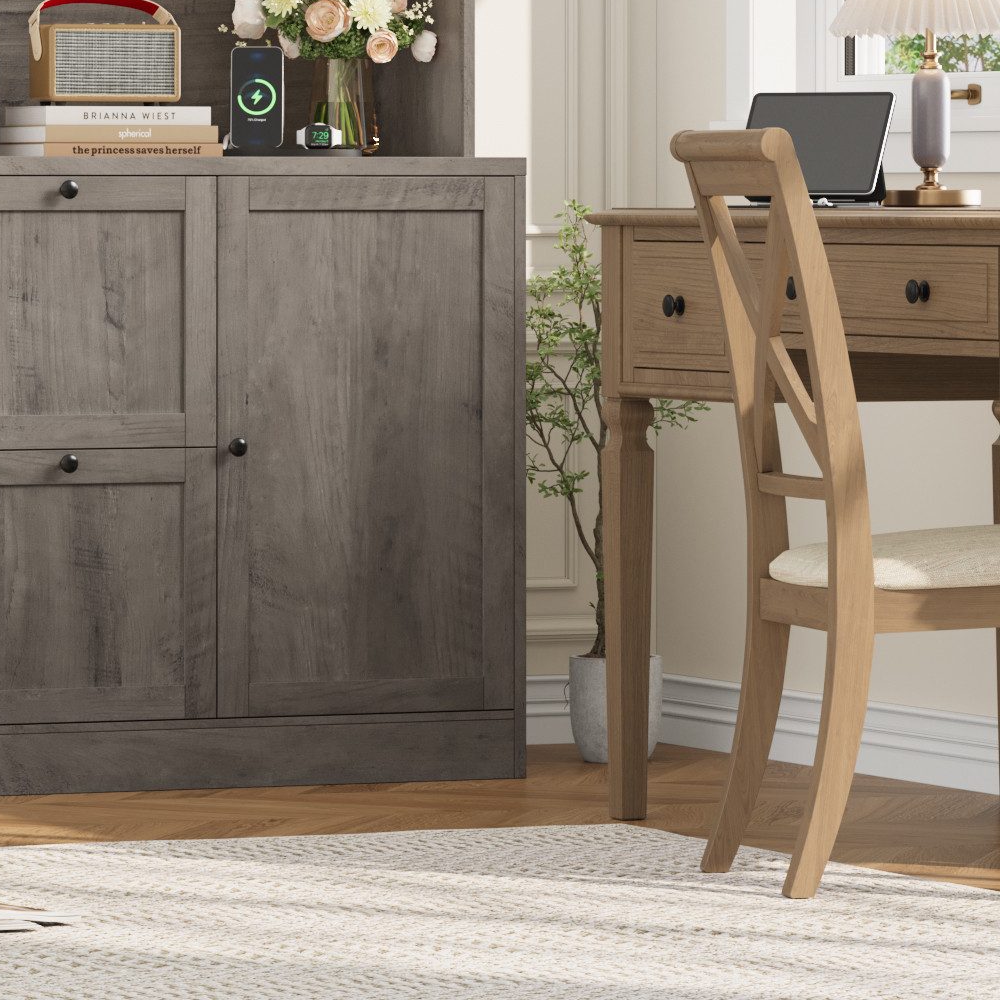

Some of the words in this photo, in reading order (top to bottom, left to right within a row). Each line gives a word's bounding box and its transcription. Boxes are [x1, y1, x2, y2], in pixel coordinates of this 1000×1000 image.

[118, 128, 152, 140] spherical
[72, 146, 90, 154] the
[91, 146, 135, 156] princess
[165, 146, 201, 154] herself
